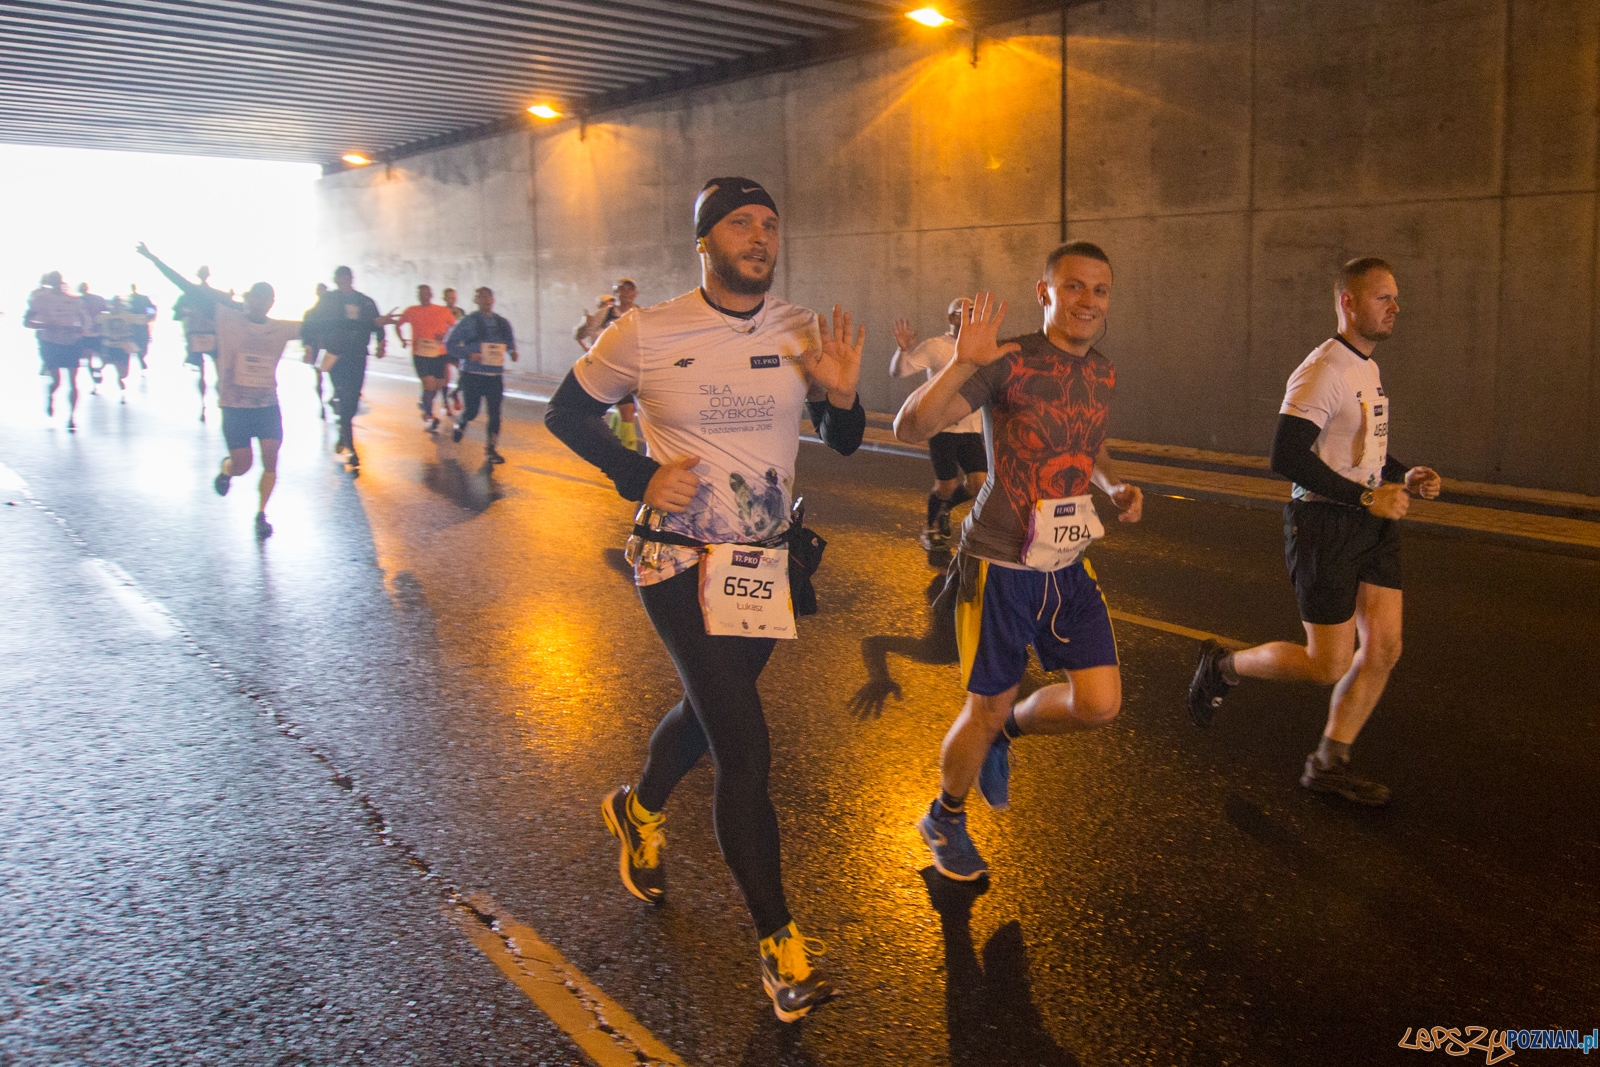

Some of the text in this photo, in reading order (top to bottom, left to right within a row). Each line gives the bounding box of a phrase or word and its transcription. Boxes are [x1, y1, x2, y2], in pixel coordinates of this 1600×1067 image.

[699, 384, 732, 396] SIŁA
[709, 395, 776, 408] ODWAGA
[699, 406, 775, 420] SZYBKOŚĆ
[700, 427, 707, 435] 9
[755, 423, 773, 431] 2016
[1053, 524, 1091, 543] 1784
[724, 576, 774, 600] 6525
[736, 602, 763, 612] Łukasz
